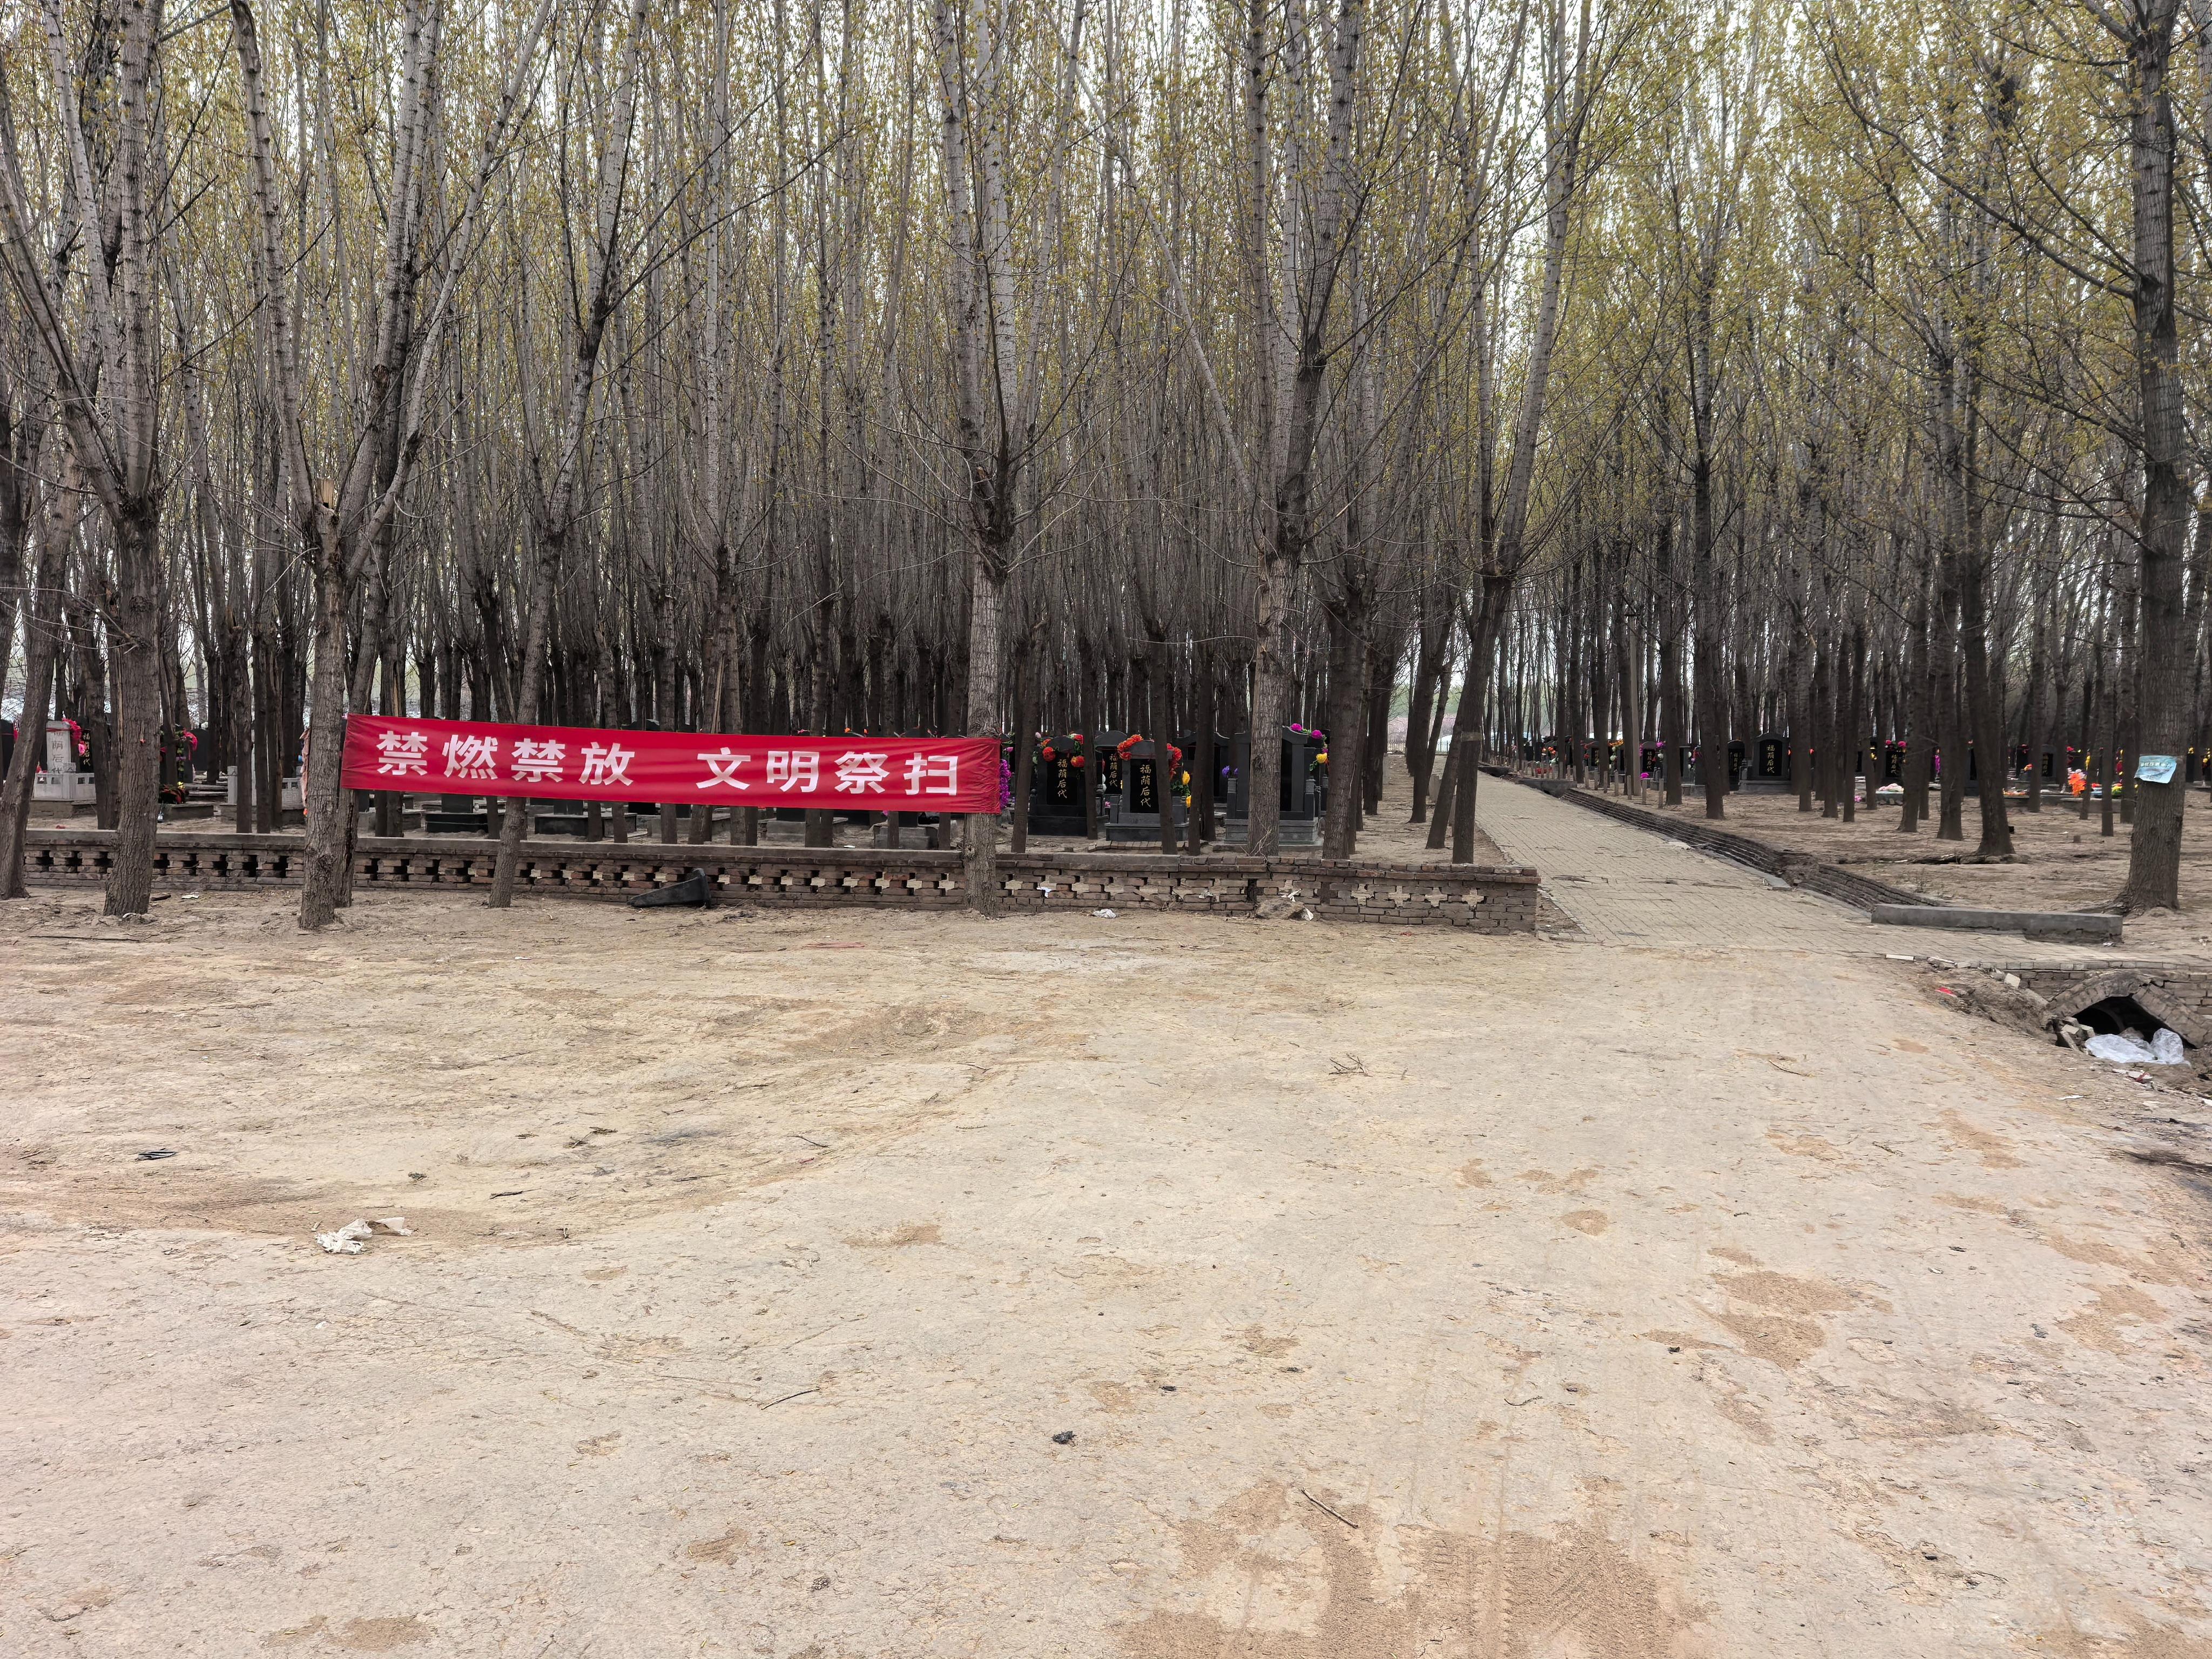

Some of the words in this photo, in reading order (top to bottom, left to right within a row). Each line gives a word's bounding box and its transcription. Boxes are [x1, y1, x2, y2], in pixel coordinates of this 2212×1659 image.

[376, 731, 636, 786] 禁燃禁放
[696, 747, 959, 795] 文明祭扫
[1057, 759, 1068, 799] 福荫后代
[1139, 764, 1151, 808] 福荫后代
